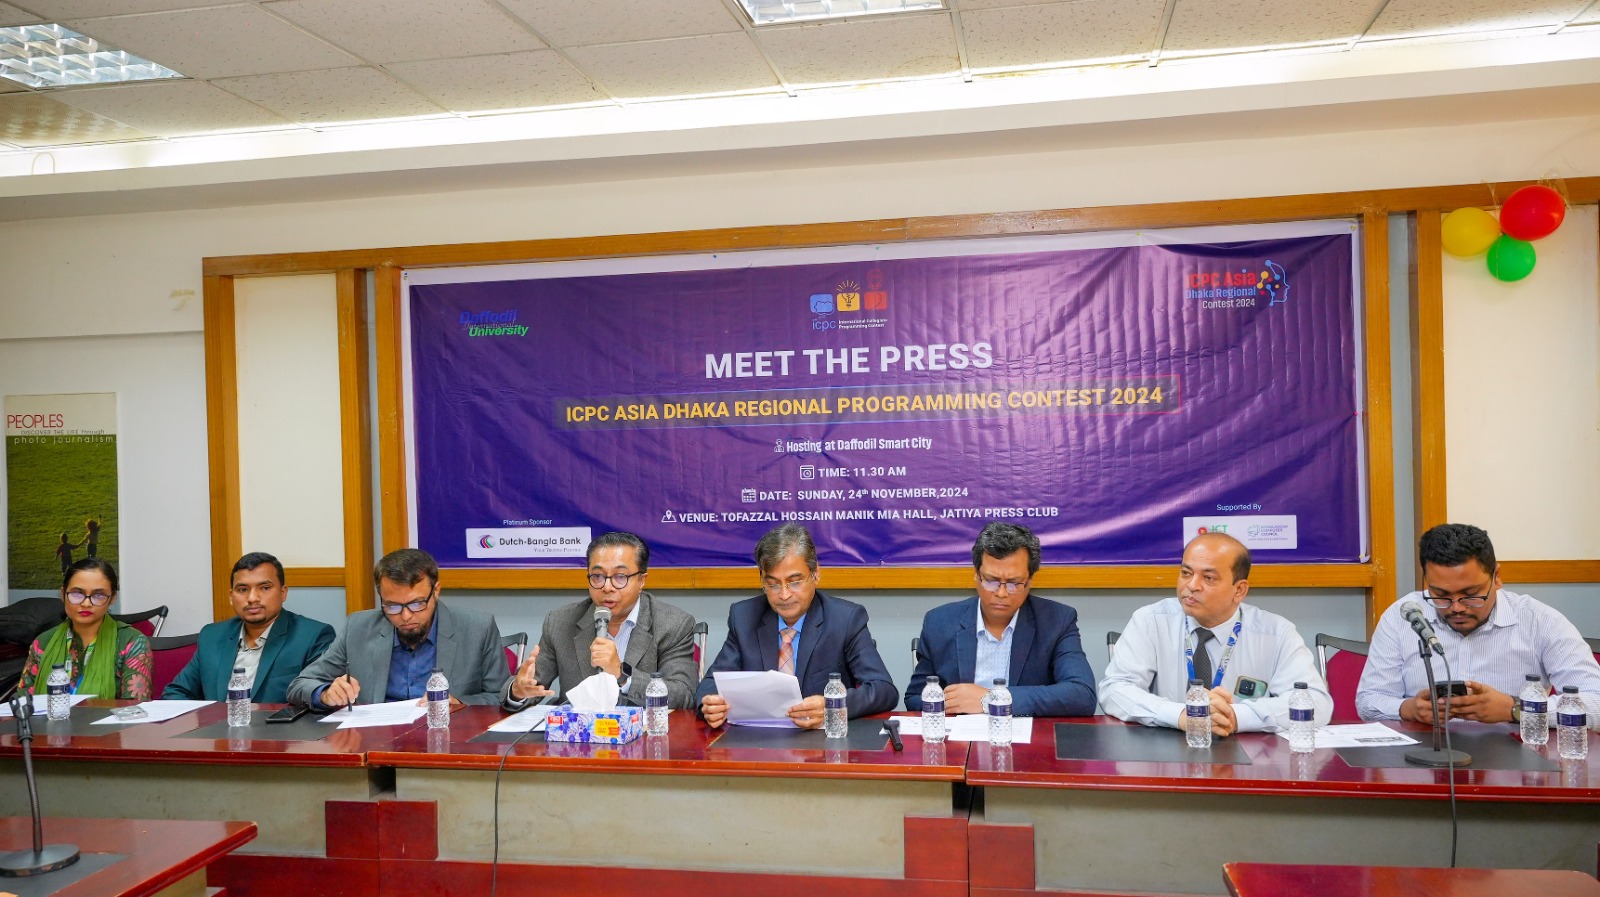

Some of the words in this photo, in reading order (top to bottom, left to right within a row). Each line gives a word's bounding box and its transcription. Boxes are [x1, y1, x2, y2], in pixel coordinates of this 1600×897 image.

[1186, 272, 1219, 288] ICPC
[1224, 270, 1257, 287] Asia
[1186, 288, 1214, 299] Dhaka
[1216, 286, 1256, 298] Regional
[1202, 299, 1234, 309] Contest
[1235, 298, 1256, 308] 2024
[459, 309, 518, 324] Daffodil
[469, 324, 529, 337] University
[812, 319, 836, 332] icpc
[705, 350, 795, 379] MEET
[803, 347, 870, 375] THE
[880, 342, 993, 372] PRESS
[566, 405, 610, 422] ICPC
[614, 403, 659, 421] ASIA
[663, 401, 730, 420] DHAKA
[734, 398, 832, 417] REGIONAL
[837, 392, 1002, 413] PROGRAMMING
[1007, 388, 1105, 409] CONTEST
[1111, 386, 1163, 406] 2024
[7, 414, 64, 429] PEOPLES
[14, 436, 47, 445] photo
[53, 435, 114, 444] journalism
[786, 440, 822, 453] Hosting
[825, 440, 836, 451] at
[837, 438, 877, 450] Daffodil
[878, 438, 910, 449] Smart
[911, 437, 932, 450] City
[818, 467, 850, 478] TIME:
[853, 466, 884, 477] 11.30
[887, 466, 907, 476] AM
[759, 490, 792, 501] DATE:
[797, 489, 846, 501] SUNDAY,
[848, 488, 869, 499] 24th
[871, 487, 969, 500] NOVEMBER,2024
[1216, 503, 1252, 511] Supported
[1253, 503, 1262, 511] By
[679, 512, 719, 523] VENUE:
[721, 512, 779, 522] TOFAZZAL
[781, 511, 833, 521] HOSSAIN
[835, 510, 874, 520] MANIK
[877, 510, 900, 520] MIA
[903, 509, 937, 521] HALL,
[939, 508, 982, 519] JATIYA
[985, 507, 1024, 518] PRESS
[1026, 507, 1059, 517] CLUB
[529, 519, 552, 527] Sponsor
[499, 537, 557, 547] Dutch-Bangla
[560, 537, 581, 545] Bank
